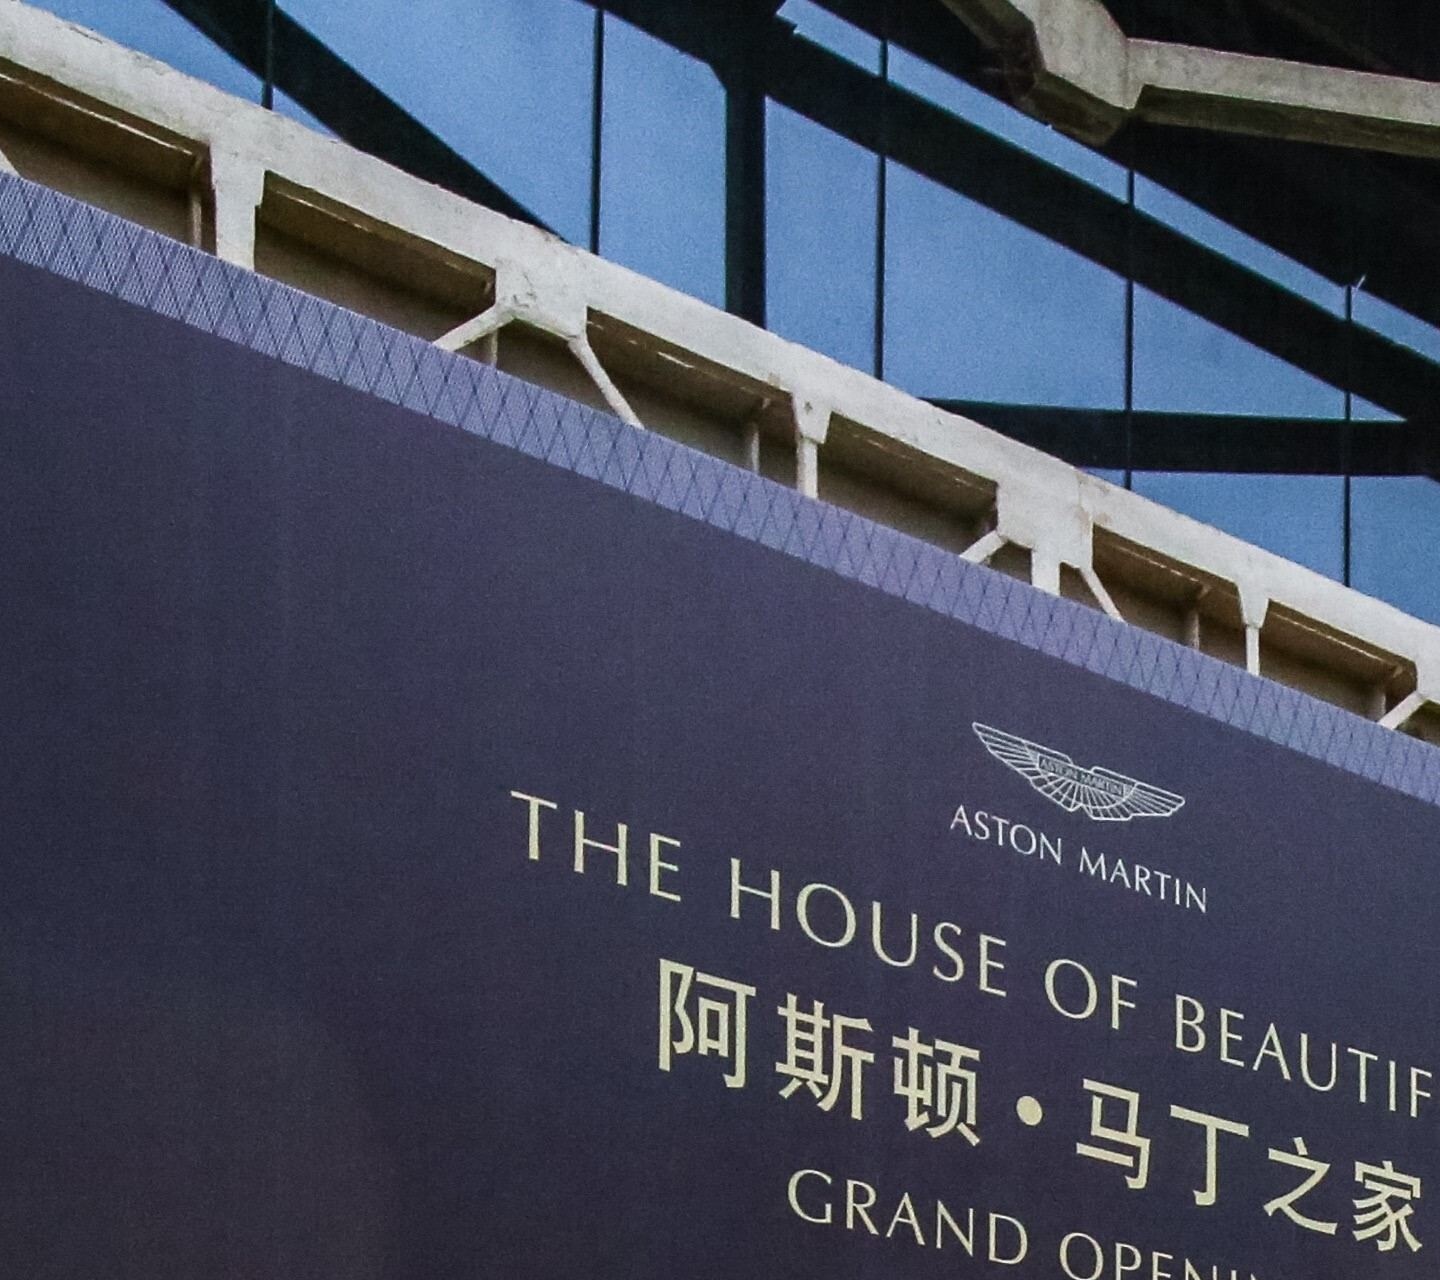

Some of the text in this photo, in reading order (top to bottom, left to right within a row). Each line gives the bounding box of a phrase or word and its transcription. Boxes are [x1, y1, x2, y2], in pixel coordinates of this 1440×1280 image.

[510, 790, 682, 902] THE
[730, 857, 1007, 997] HOUSE
[1044, 958, 1138, 1030] OF
[950, 804, 1207, 914] ASTON MARTIN
[658, 958, 1423, 1253] 阿斯顿·马丁之家
[787, 1169, 1028, 1265] GRAND
